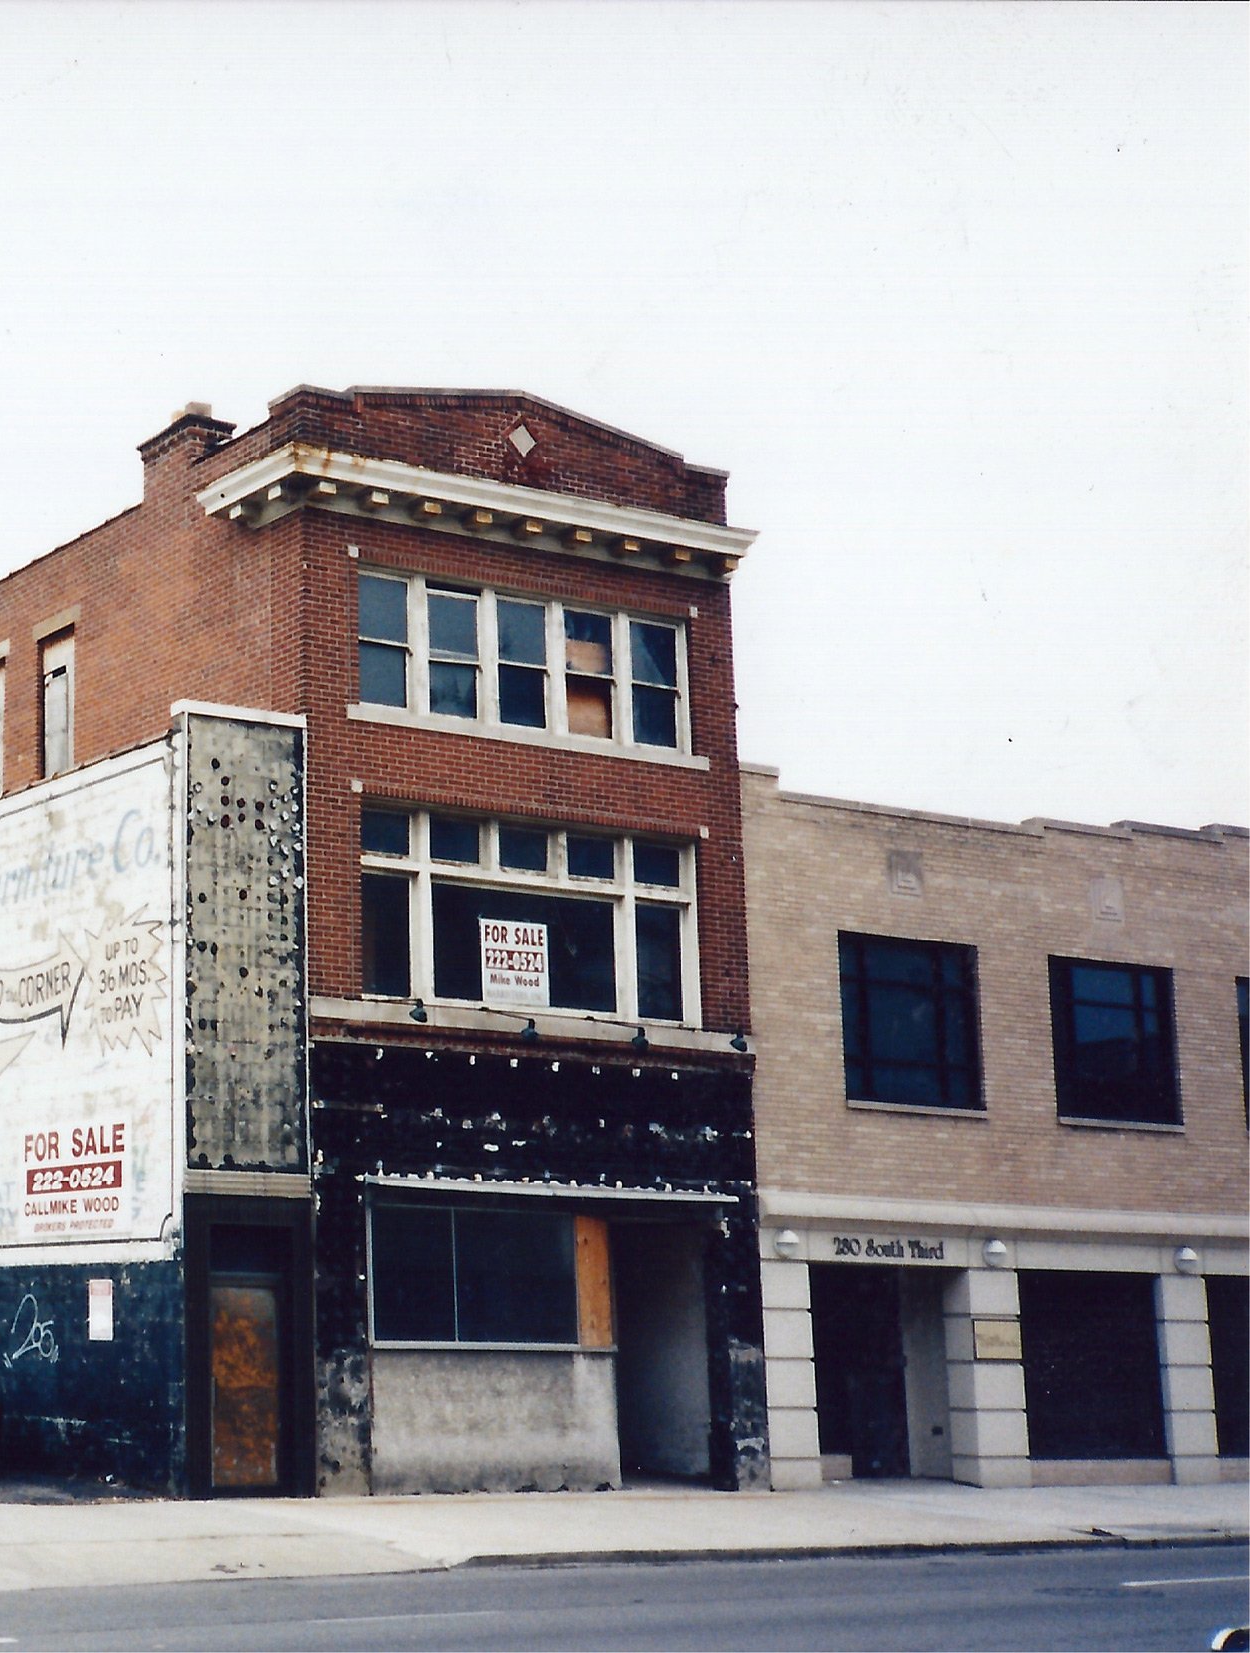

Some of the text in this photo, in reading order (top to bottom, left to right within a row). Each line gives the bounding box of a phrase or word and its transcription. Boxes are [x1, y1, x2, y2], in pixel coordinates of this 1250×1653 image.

[112, 808, 161, 874] Co.
[484, 924, 544, 947] FOR SALE
[105, 937, 139, 961] UP TO
[486, 950, 543, 971] 222-0524
[18, 961, 71, 1008] CORNER
[100, 968, 115, 994] 36
[490, 973, 540, 987] Mike Wood
[114, 993, 144, 1021] PAY
[24, 1123, 125, 1162] FOR SALE
[32, 1165, 115, 1191] 222-0524
[82, 1196, 120, 1213] WOOD
[833, 1236, 945, 1260] 280 South Third
